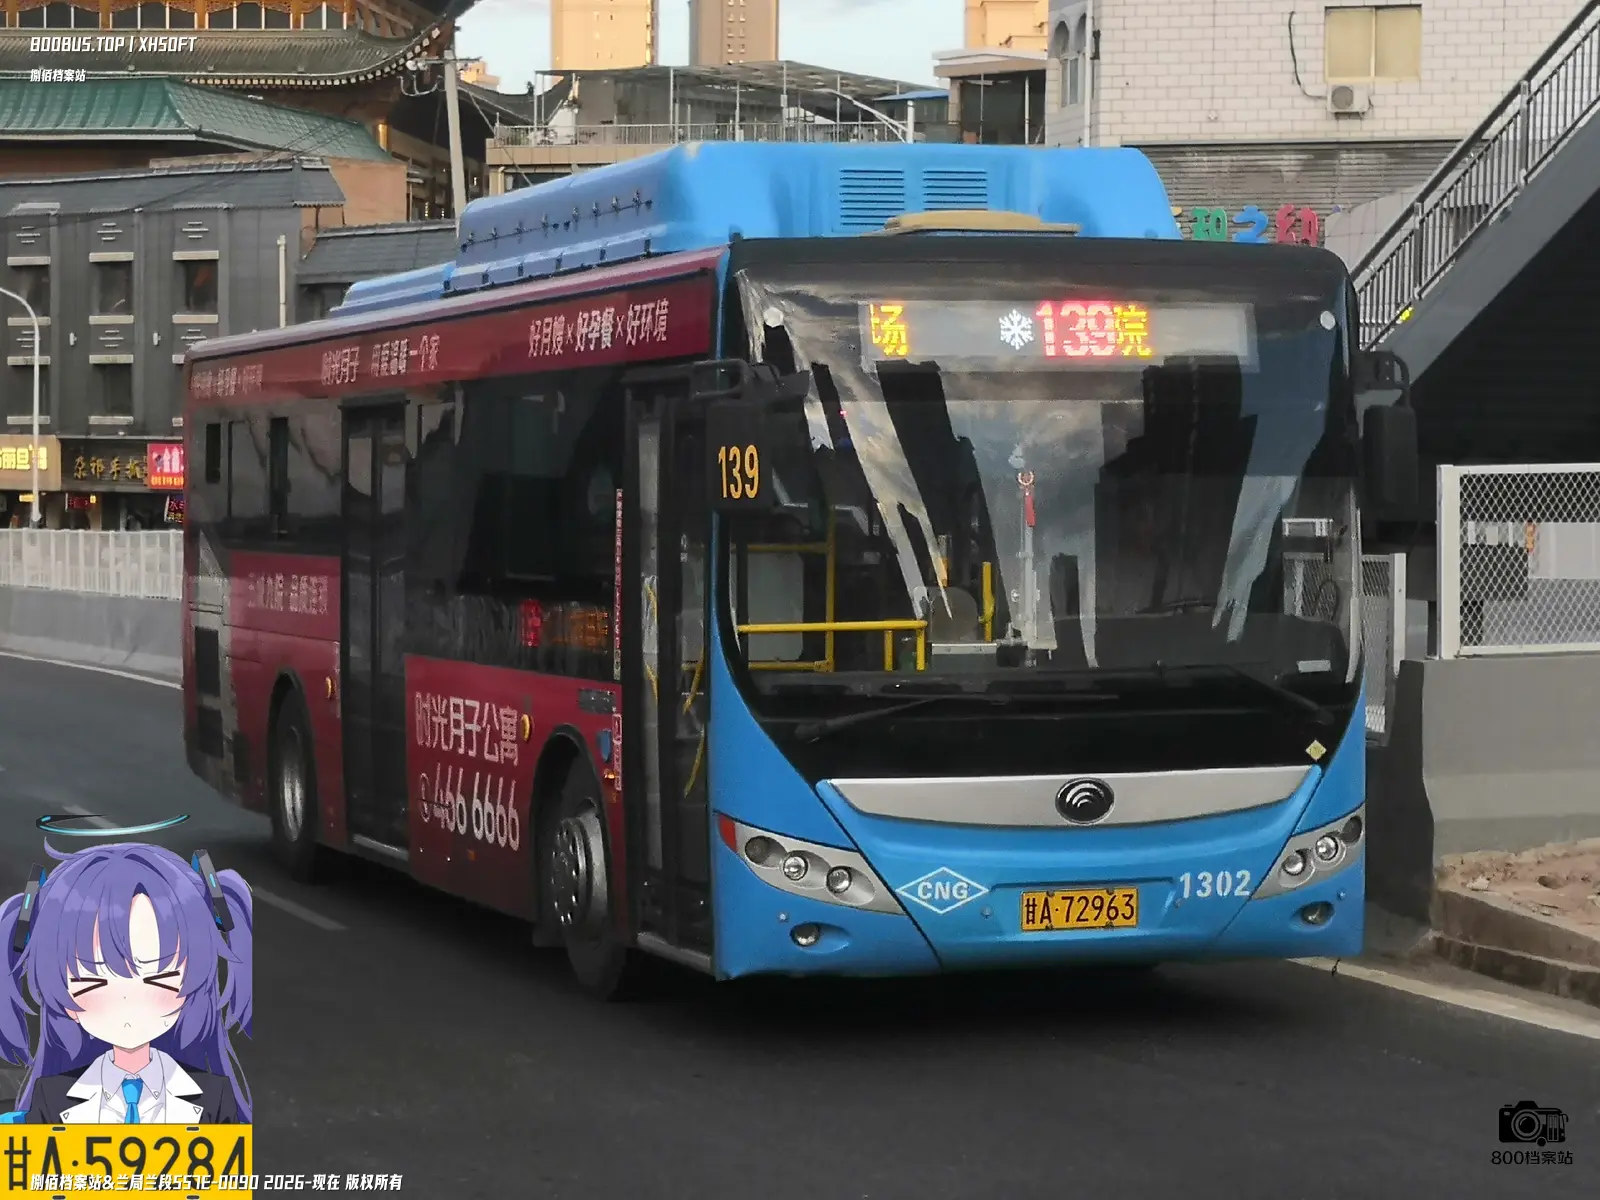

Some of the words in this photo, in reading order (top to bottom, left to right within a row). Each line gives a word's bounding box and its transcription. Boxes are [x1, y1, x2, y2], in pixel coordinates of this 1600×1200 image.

[1036, 301, 1116, 357] 139
[718, 444, 759, 499] 139
[415, 692, 518, 766] 时光月子公寓
[472, 772, 521, 851] 6666
[917, 880, 969, 900] CNG
[1179, 869, 1252, 899] 1302
